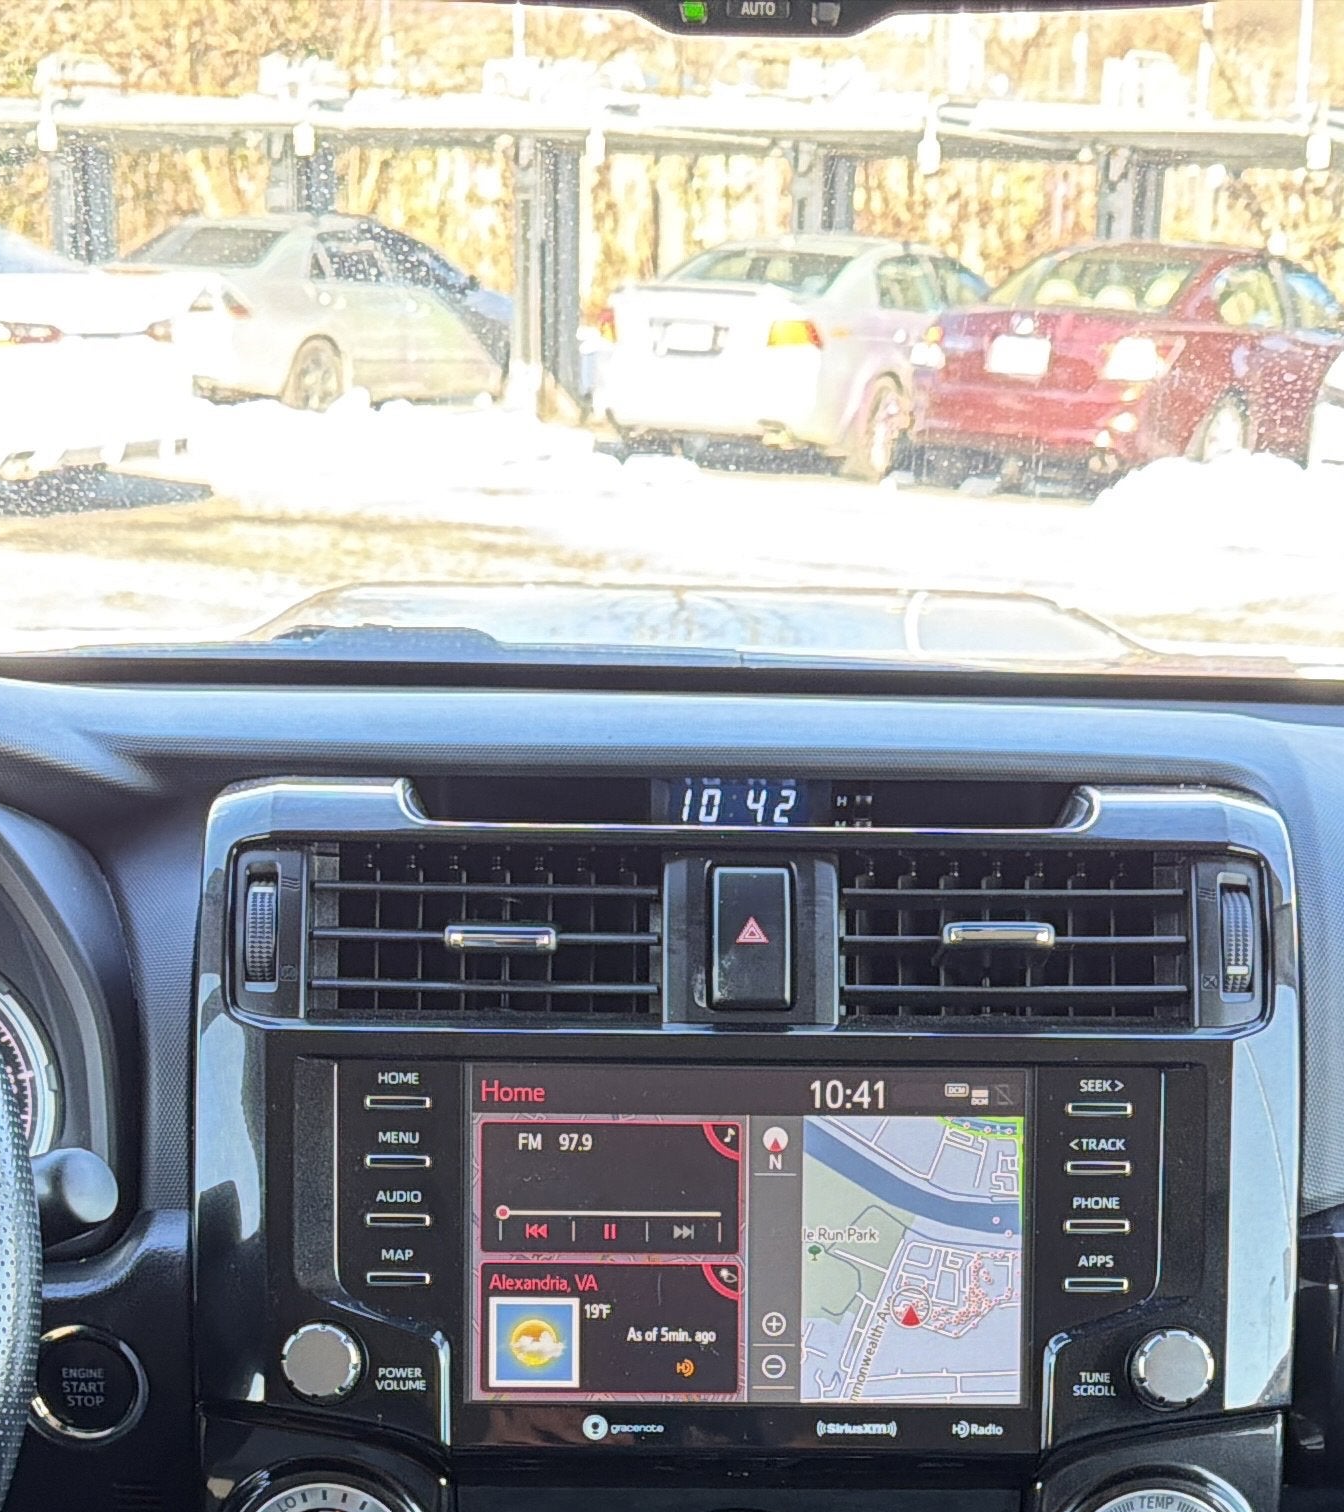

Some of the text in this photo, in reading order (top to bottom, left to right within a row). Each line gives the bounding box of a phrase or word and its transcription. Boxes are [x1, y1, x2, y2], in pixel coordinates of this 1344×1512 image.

[740, 1, 776, 17] AUTO
[378, 1072, 419, 1085] HOME
[481, 1079, 545, 1102] Home
[809, 1080, 887, 1110] 10:41
[378, 1132, 419, 1144] MENU
[517, 1133, 593, 1152] FM 97.9
[769, 1155, 782, 1170] N
[376, 1190, 422, 1203] AUDIO
[1073, 1196, 1121, 1210] PHONE
[817, 1227, 845, 1242] Run
[846, 1227, 877, 1242] Park
[381, 1249, 414, 1261] MAP
[1078, 1255, 1115, 1268] APPS
[489, 1273, 598, 1293] Alexandria, VA
[584, 1303, 612, 1319] 19°F
[626, 1326, 717, 1346] As of 5min. ago
[61, 1368, 104, 1378] ENGINE
[378, 1367, 422, 1379] POWER
[1079, 1372, 1111, 1384] TUNE
[62, 1382, 105, 1393] START
[375, 1379, 427, 1391] VOLUME
[1073, 1384, 1117, 1397] SCROLL
[67, 1396, 104, 1407] STOP
[610, 1422, 665, 1435] gracenote
[971, 1422, 1003, 1435] Radio
[277, 1496, 297, 1512] LO
[1139, 1496, 1175, 1510] TEMP
